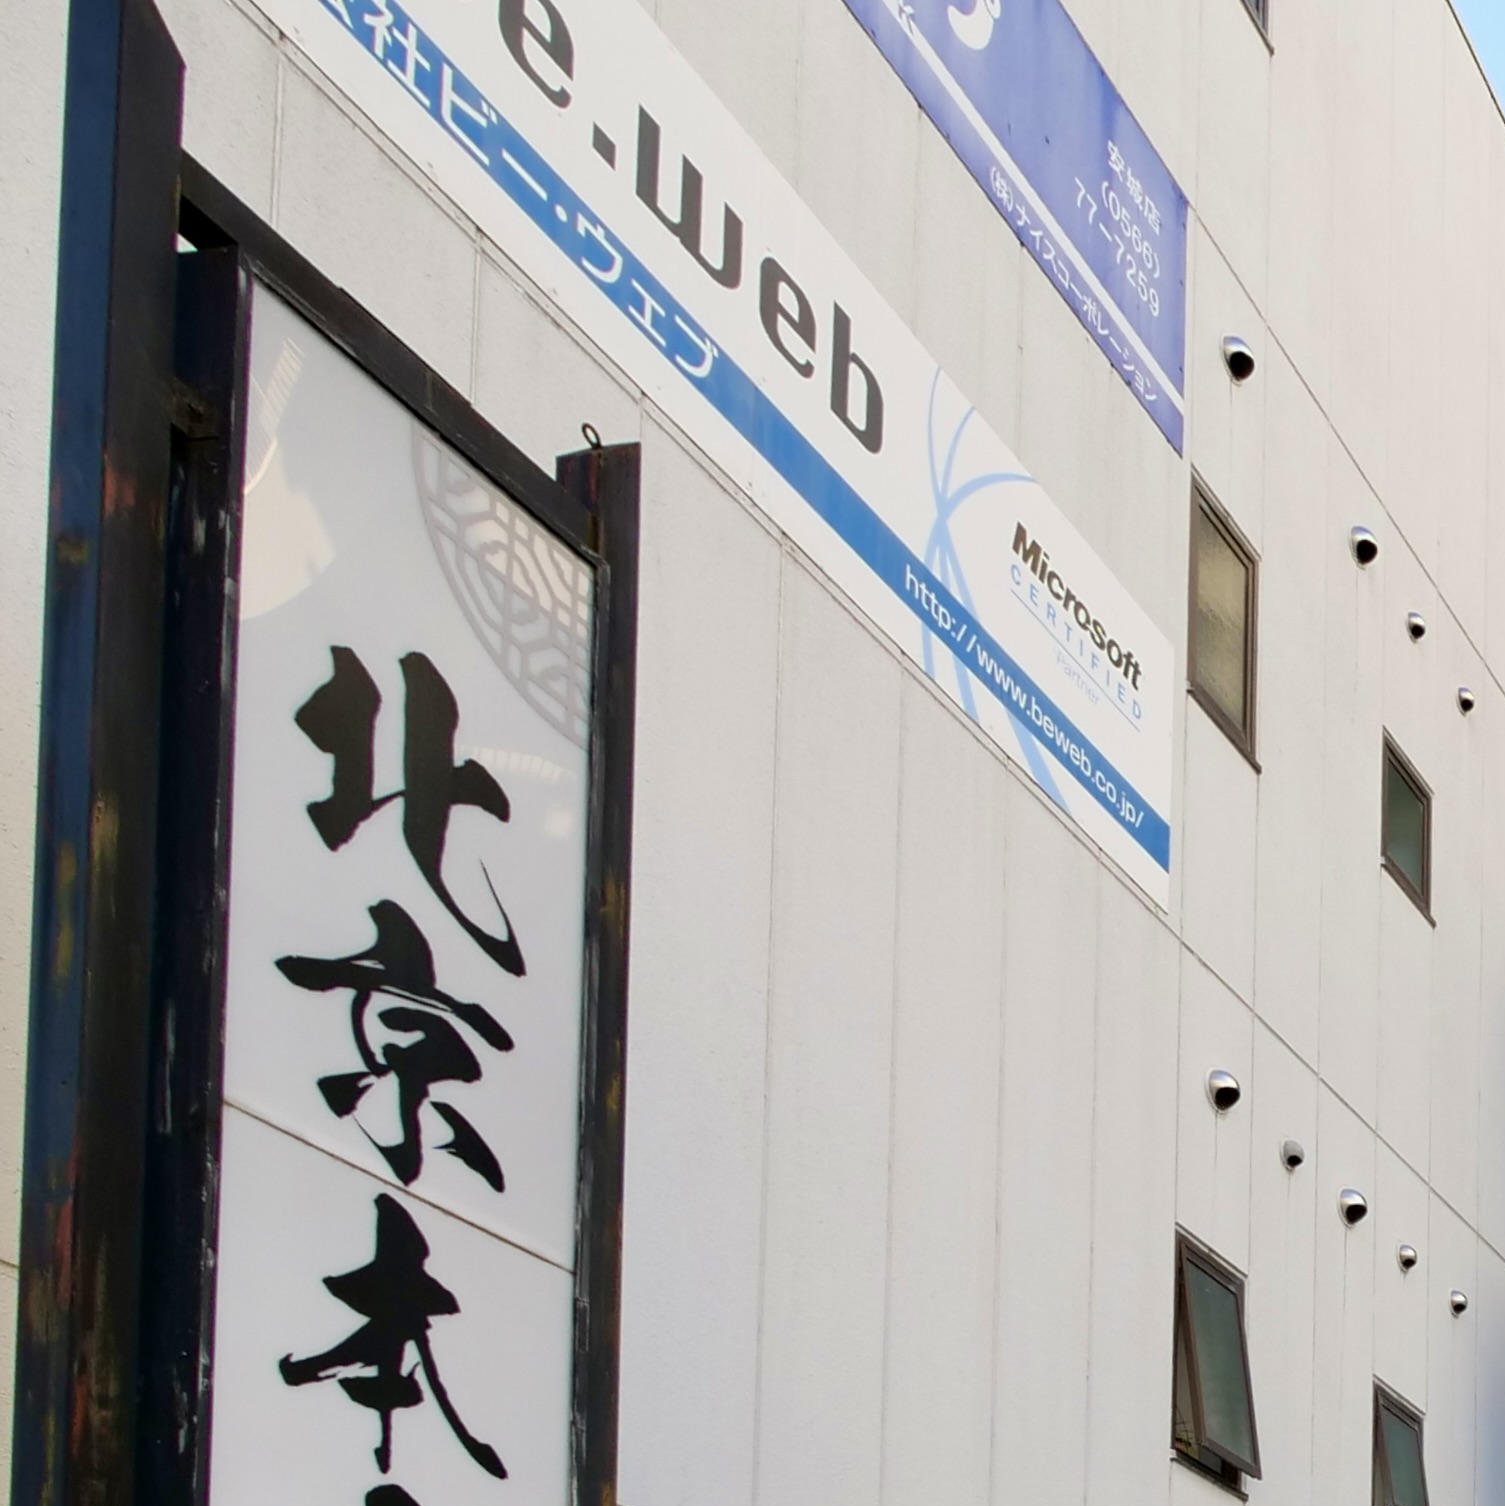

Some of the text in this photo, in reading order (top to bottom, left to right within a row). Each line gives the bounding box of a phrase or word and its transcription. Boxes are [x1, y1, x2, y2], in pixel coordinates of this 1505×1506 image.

[1101, 180, 1161, 278] (0566)
[1107, 140, 1161, 236] 安城店
[1010, 564, 1143, 720] CERTIFIED
[1011, 521, 1143, 691] Microsoft
[905, 564, 1145, 829] http://www.beweb.co.jp/
